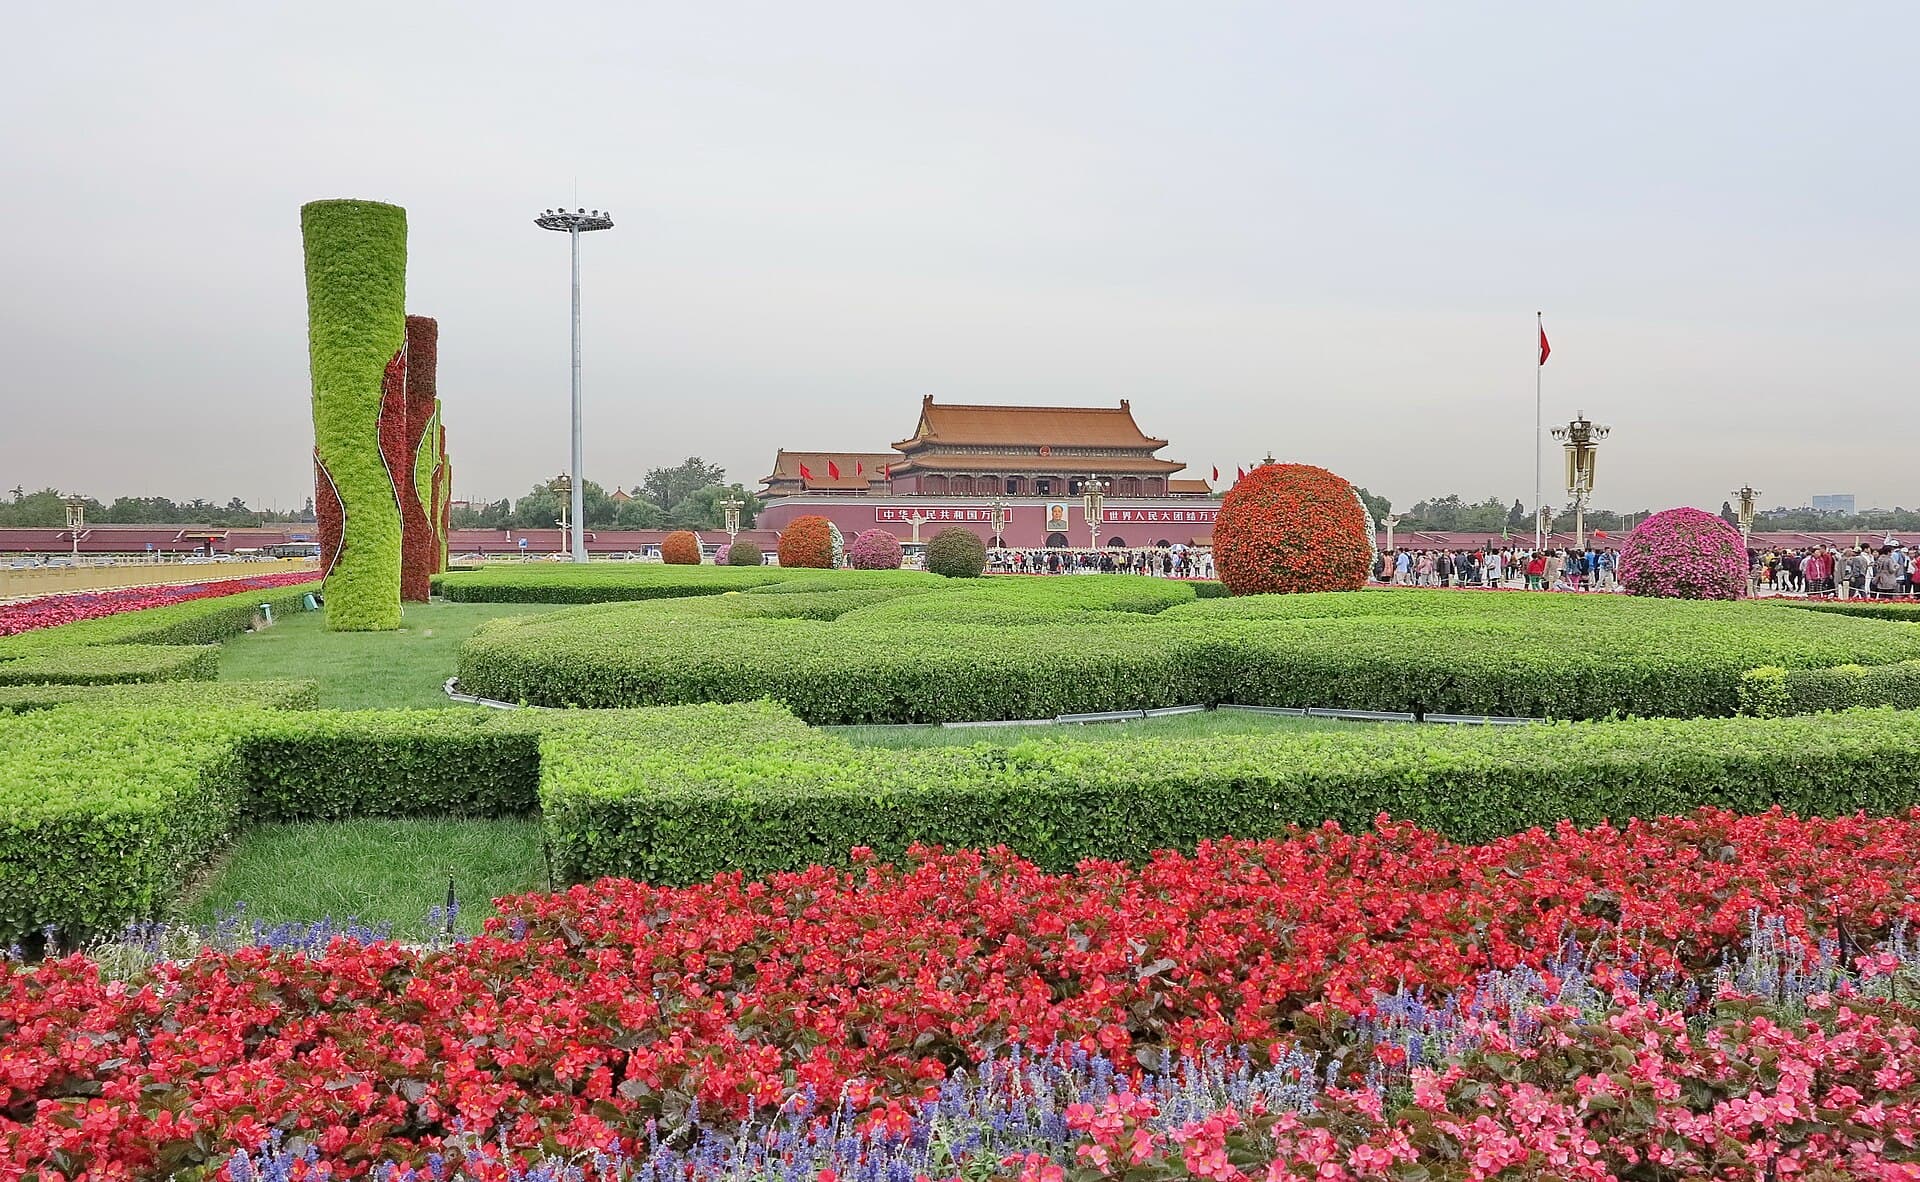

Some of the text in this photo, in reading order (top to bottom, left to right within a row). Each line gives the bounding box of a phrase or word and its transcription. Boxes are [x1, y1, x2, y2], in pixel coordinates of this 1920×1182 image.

[883, 510, 1003, 520] 中华人民共和国万
